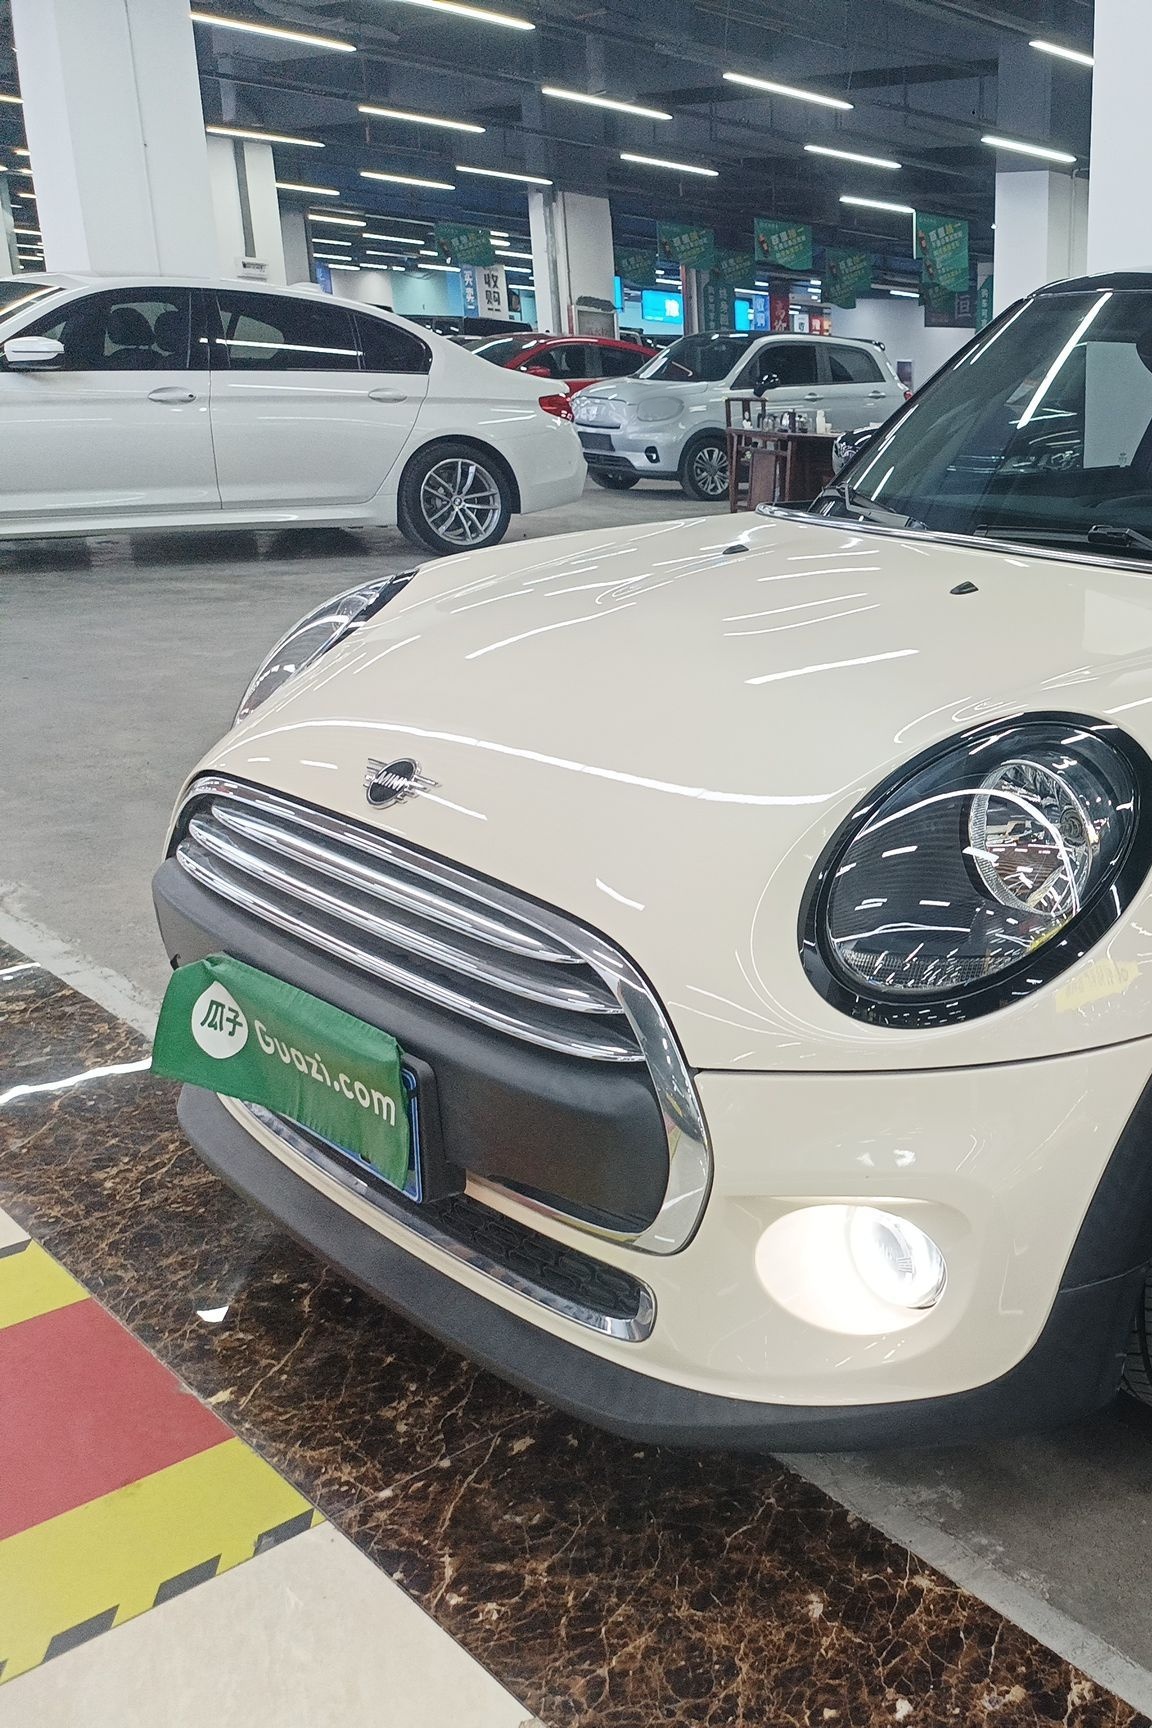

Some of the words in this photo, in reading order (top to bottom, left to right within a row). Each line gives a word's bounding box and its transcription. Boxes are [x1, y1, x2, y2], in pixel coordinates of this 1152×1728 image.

[483, 273, 501, 306] 收购
[200, 1000, 243, 1037] 瓜子
[254, 1019, 396, 1127] Guazi.com
